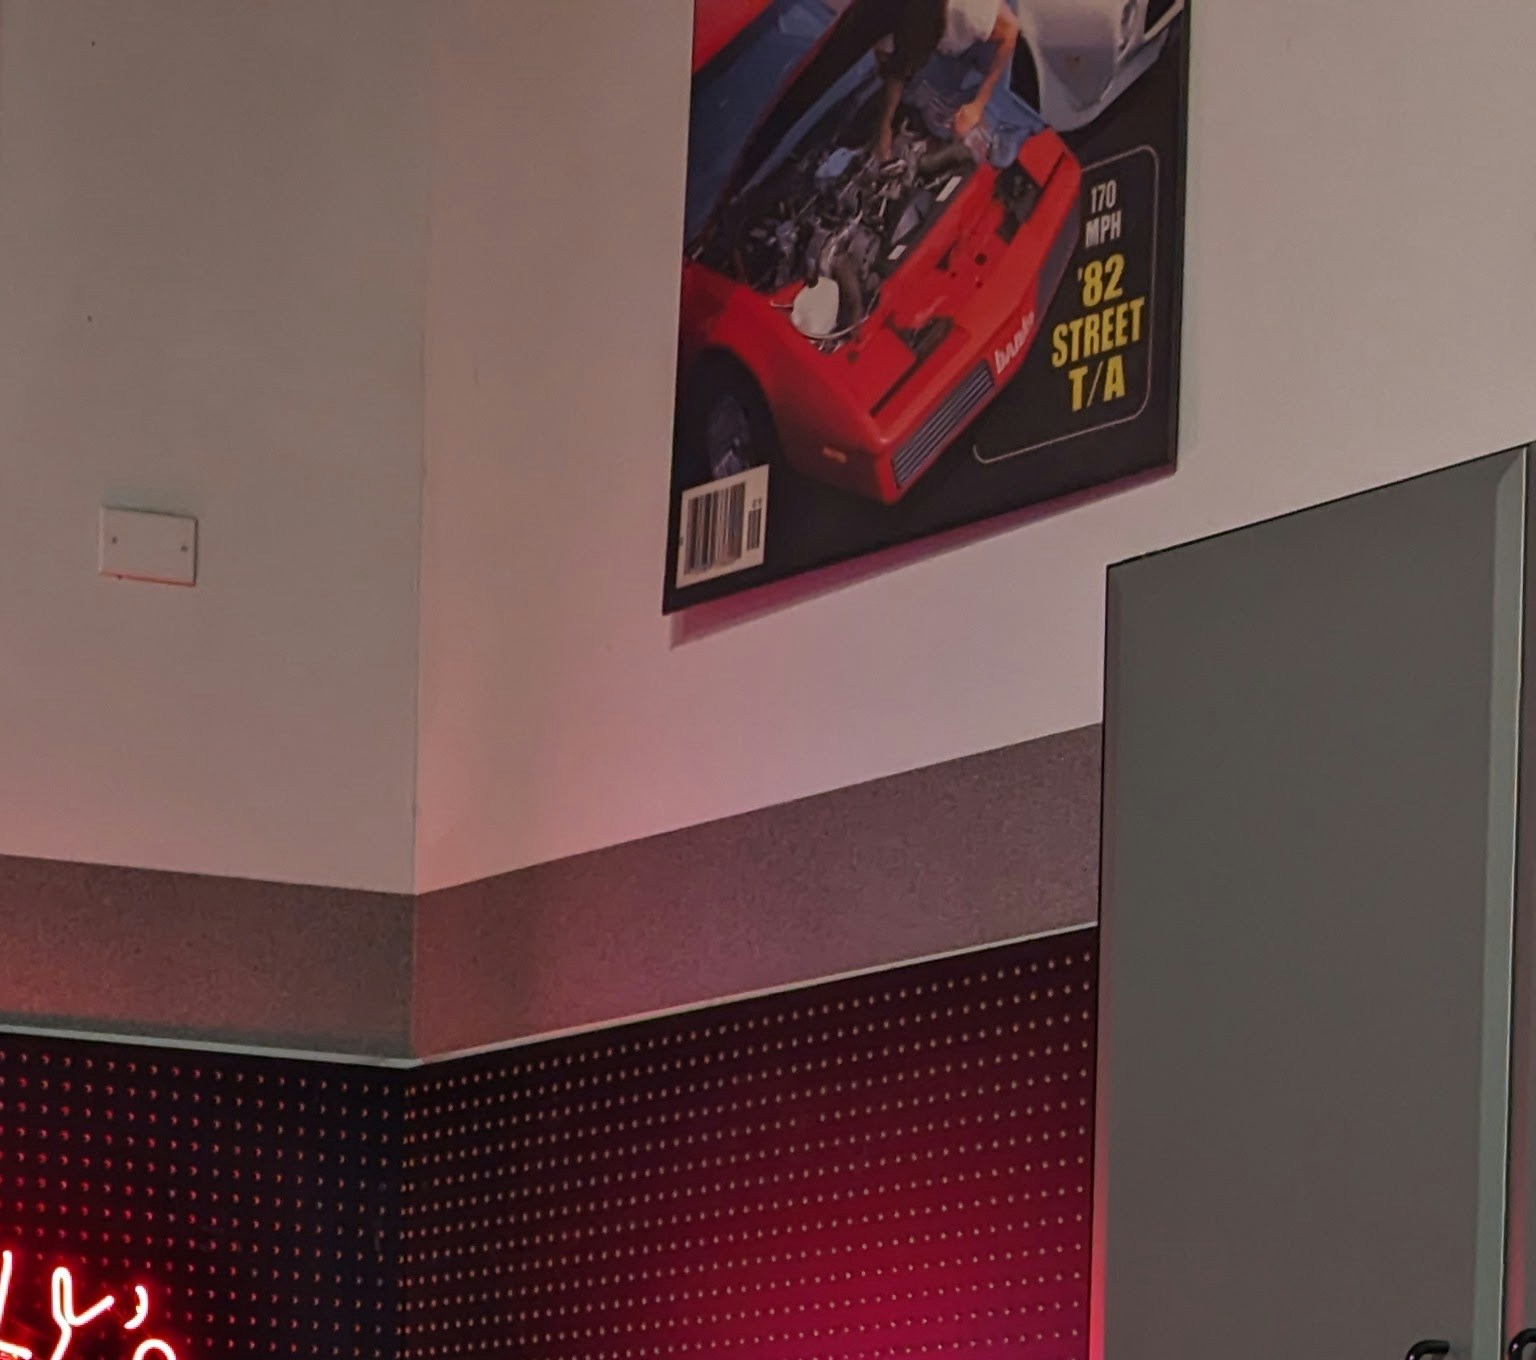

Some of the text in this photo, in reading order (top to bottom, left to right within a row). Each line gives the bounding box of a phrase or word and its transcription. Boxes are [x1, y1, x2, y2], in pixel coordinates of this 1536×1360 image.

[1090, 179, 1117, 213] 170
[1085, 210, 1122, 248] MPH
[1077, 253, 1125, 307] '82
[1051, 296, 1145, 368] STREET
[1068, 354, 1125, 412] T/A
